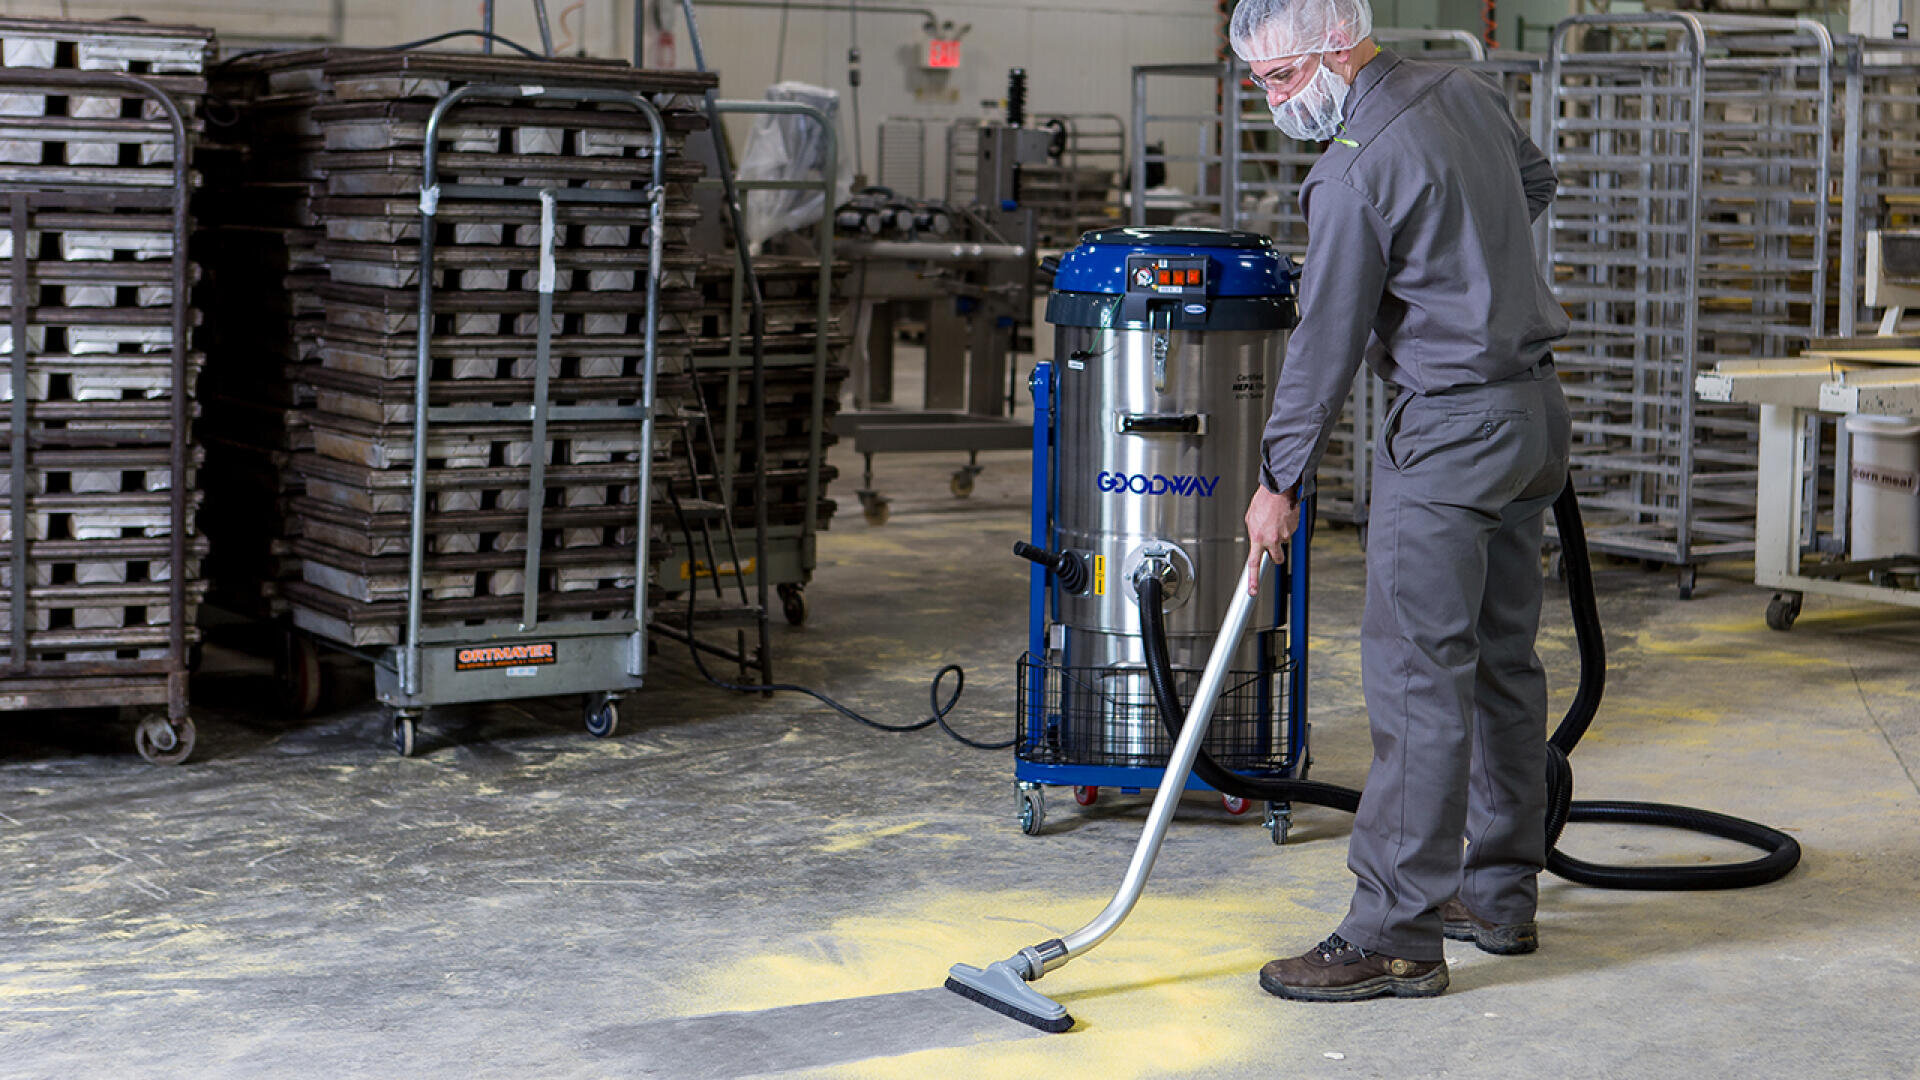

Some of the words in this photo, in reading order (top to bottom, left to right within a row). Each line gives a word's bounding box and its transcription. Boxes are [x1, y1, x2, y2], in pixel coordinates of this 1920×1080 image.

[929, 40, 960, 67] EXIT
[1097, 471, 1220, 497] GOODWAY
[1853, 468, 1879, 481] corn
[1882, 474, 1912, 488] meal
[458, 644, 553, 663] ORTMAYER
